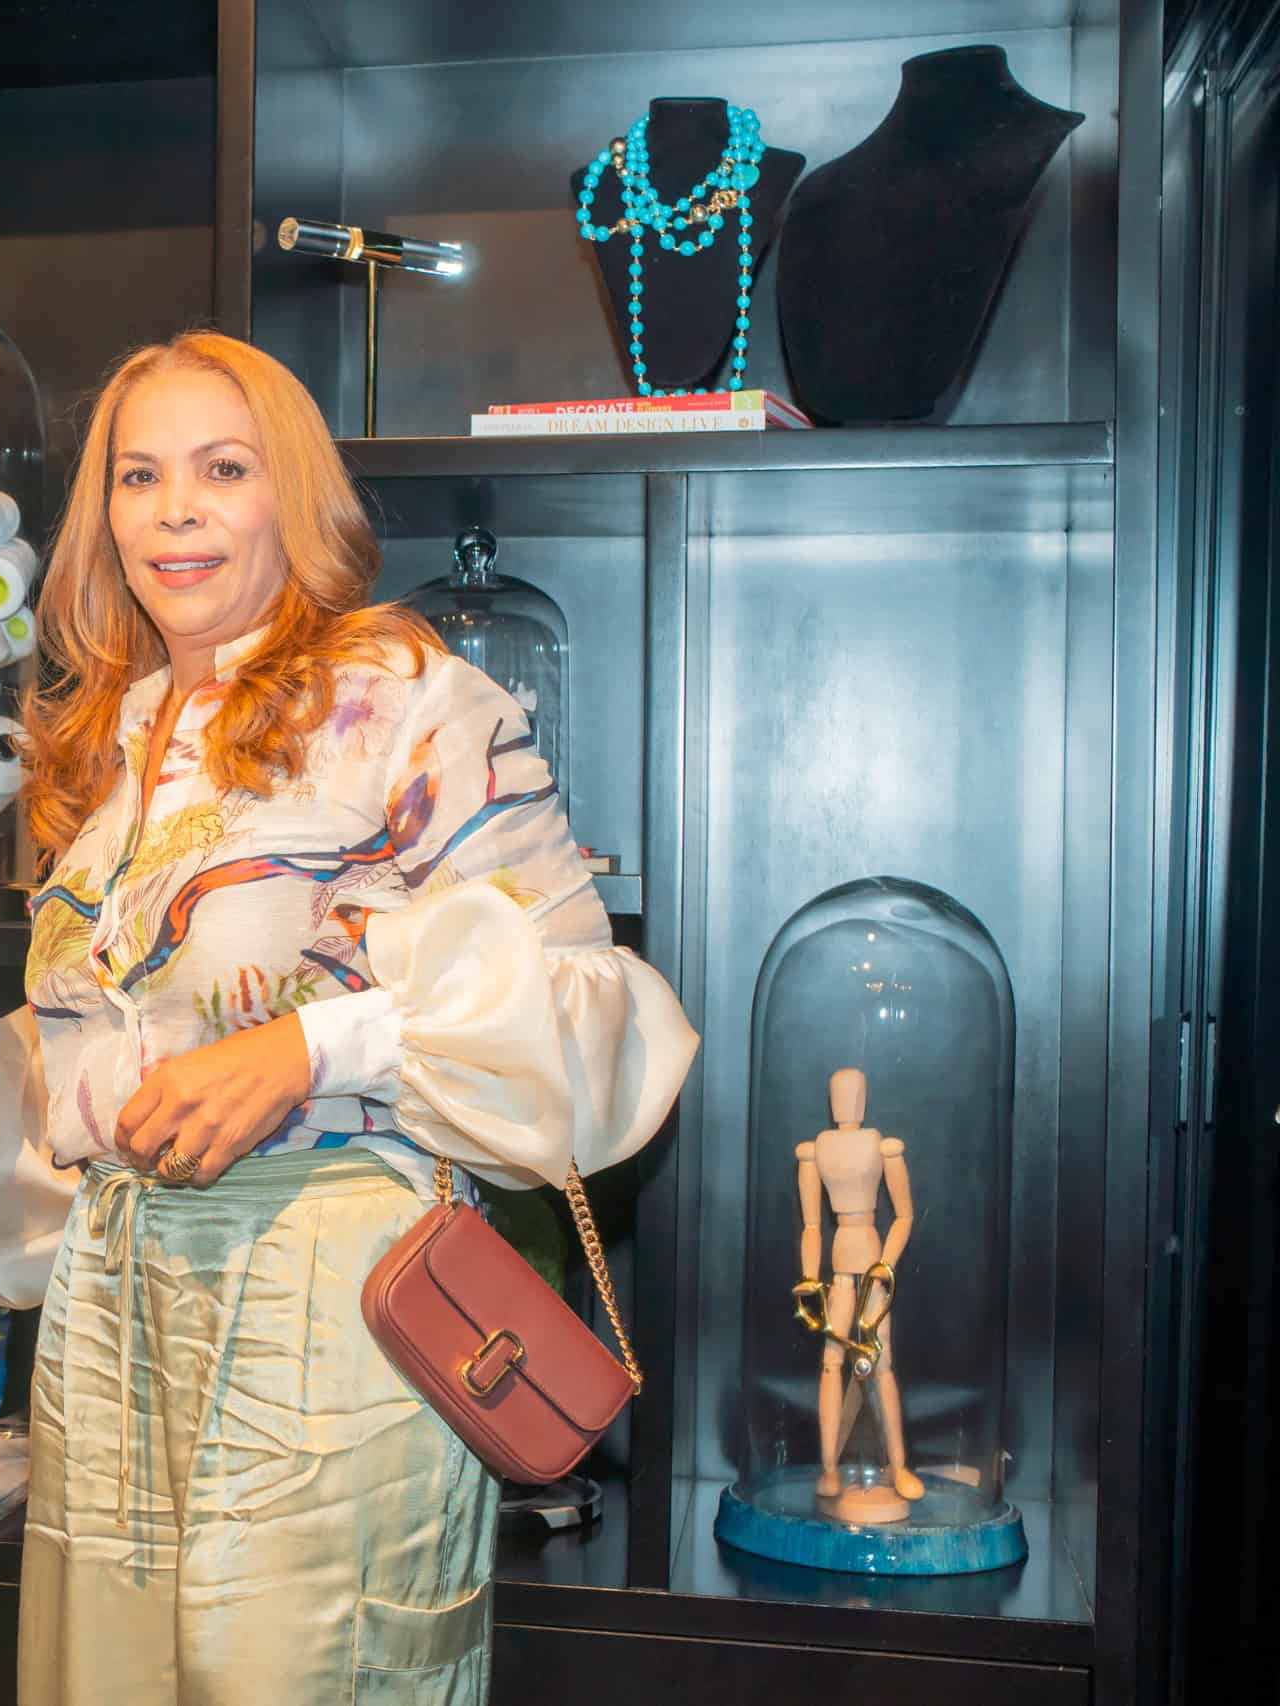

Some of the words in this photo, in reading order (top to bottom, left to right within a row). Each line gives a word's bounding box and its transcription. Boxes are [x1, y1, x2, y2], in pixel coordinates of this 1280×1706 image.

[555, 402, 634, 415] DECORATE
[547, 416, 608, 432] DREAM
[616, 415, 673, 432] DESIGN
[681, 415, 721, 431] LIVE
